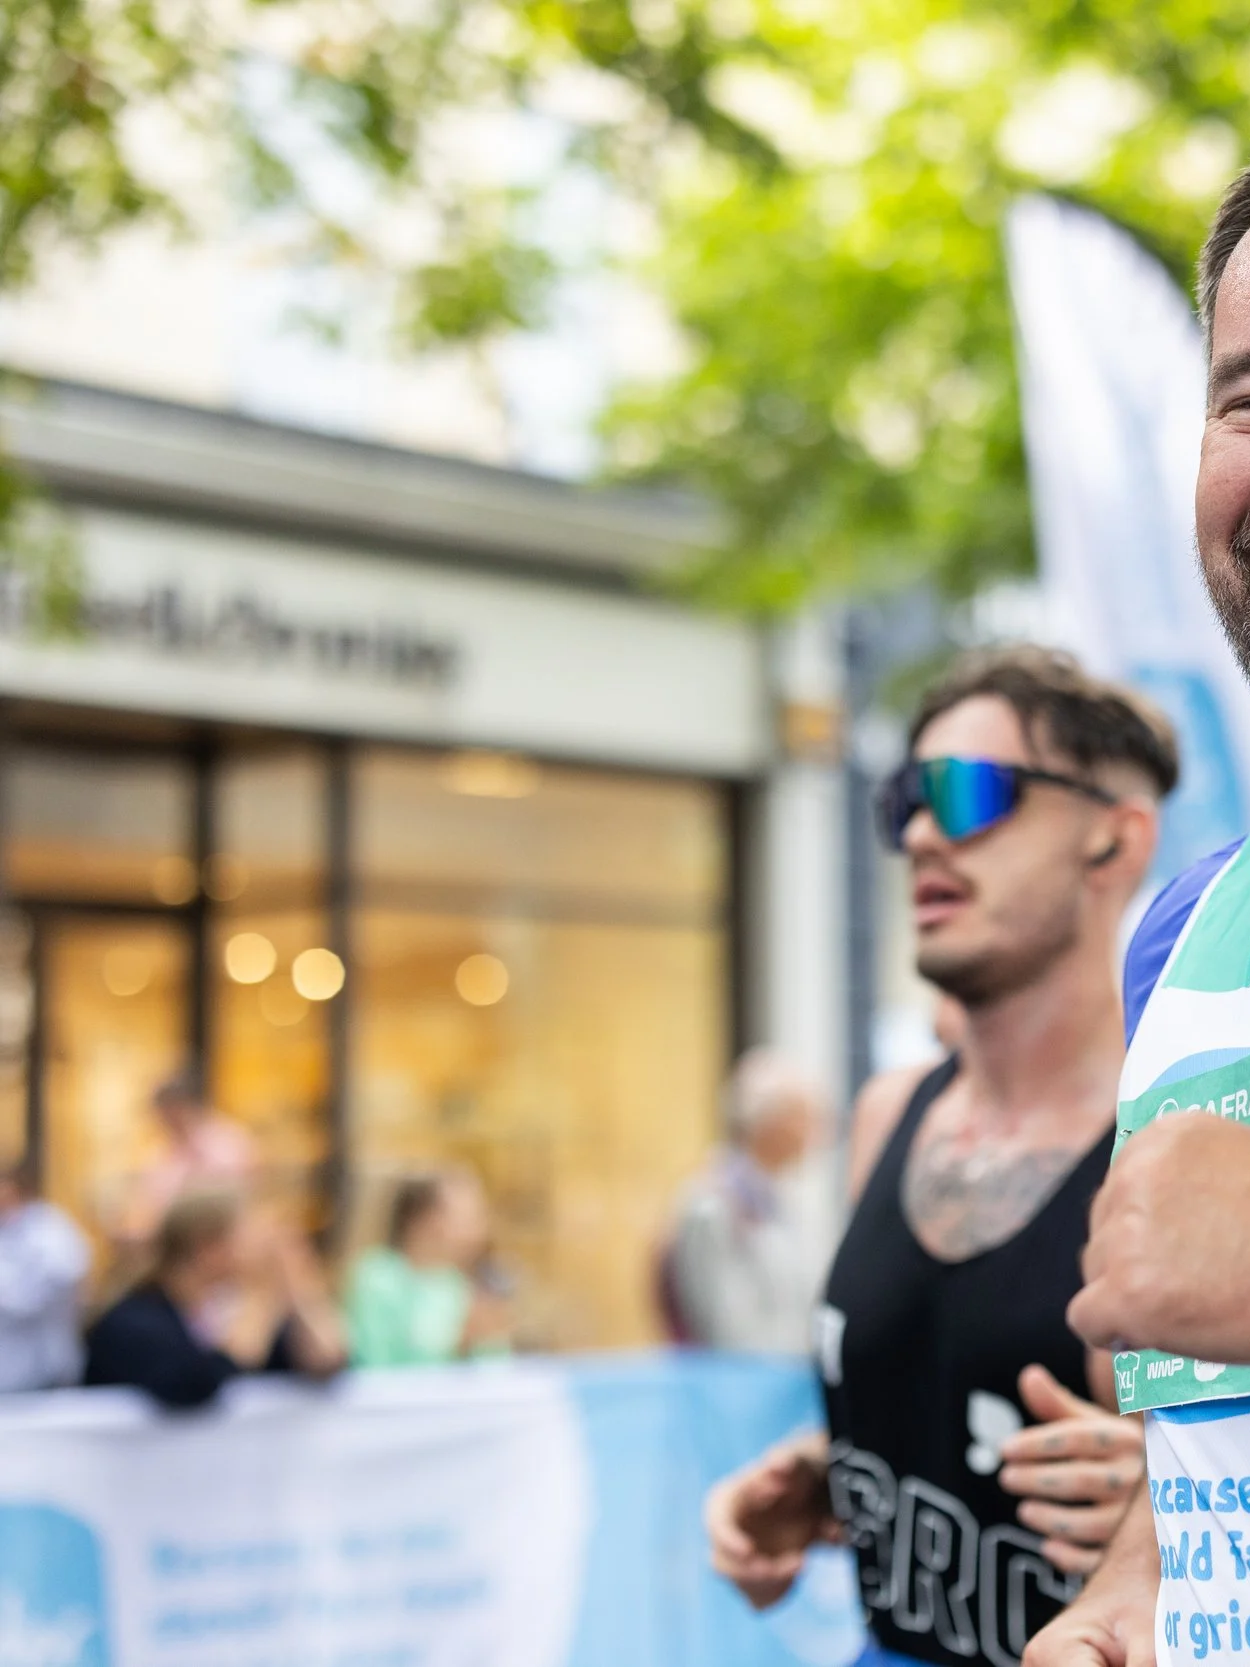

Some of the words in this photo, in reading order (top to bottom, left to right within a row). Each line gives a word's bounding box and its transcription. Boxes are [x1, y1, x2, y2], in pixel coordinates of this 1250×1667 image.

[1119, 1371, 1133, 1389] XL
[1147, 1358, 1184, 1380] WMP
[1165, 1610, 1181, 1648] or
